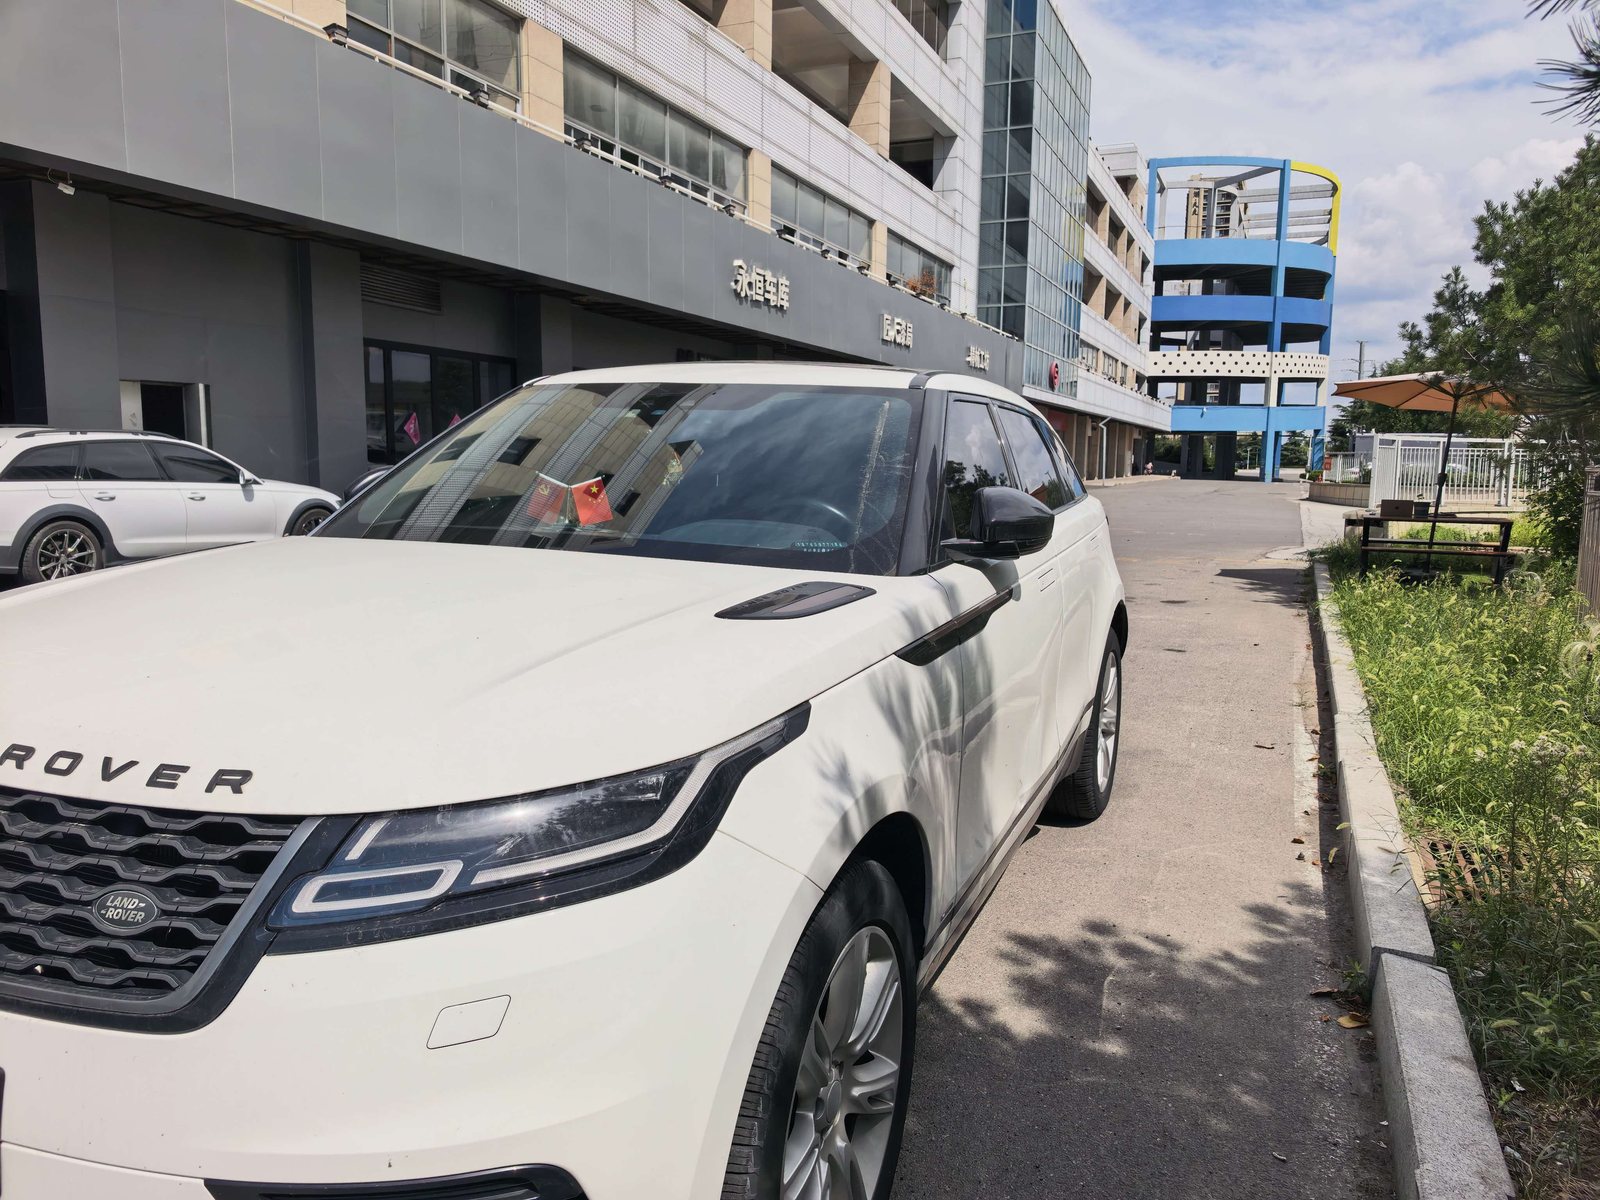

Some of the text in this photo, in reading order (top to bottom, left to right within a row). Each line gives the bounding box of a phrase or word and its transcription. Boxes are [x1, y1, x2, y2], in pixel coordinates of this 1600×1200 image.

[730, 259, 790, 310] 永恒车库
[0, 743, 254, 795] ROVER
